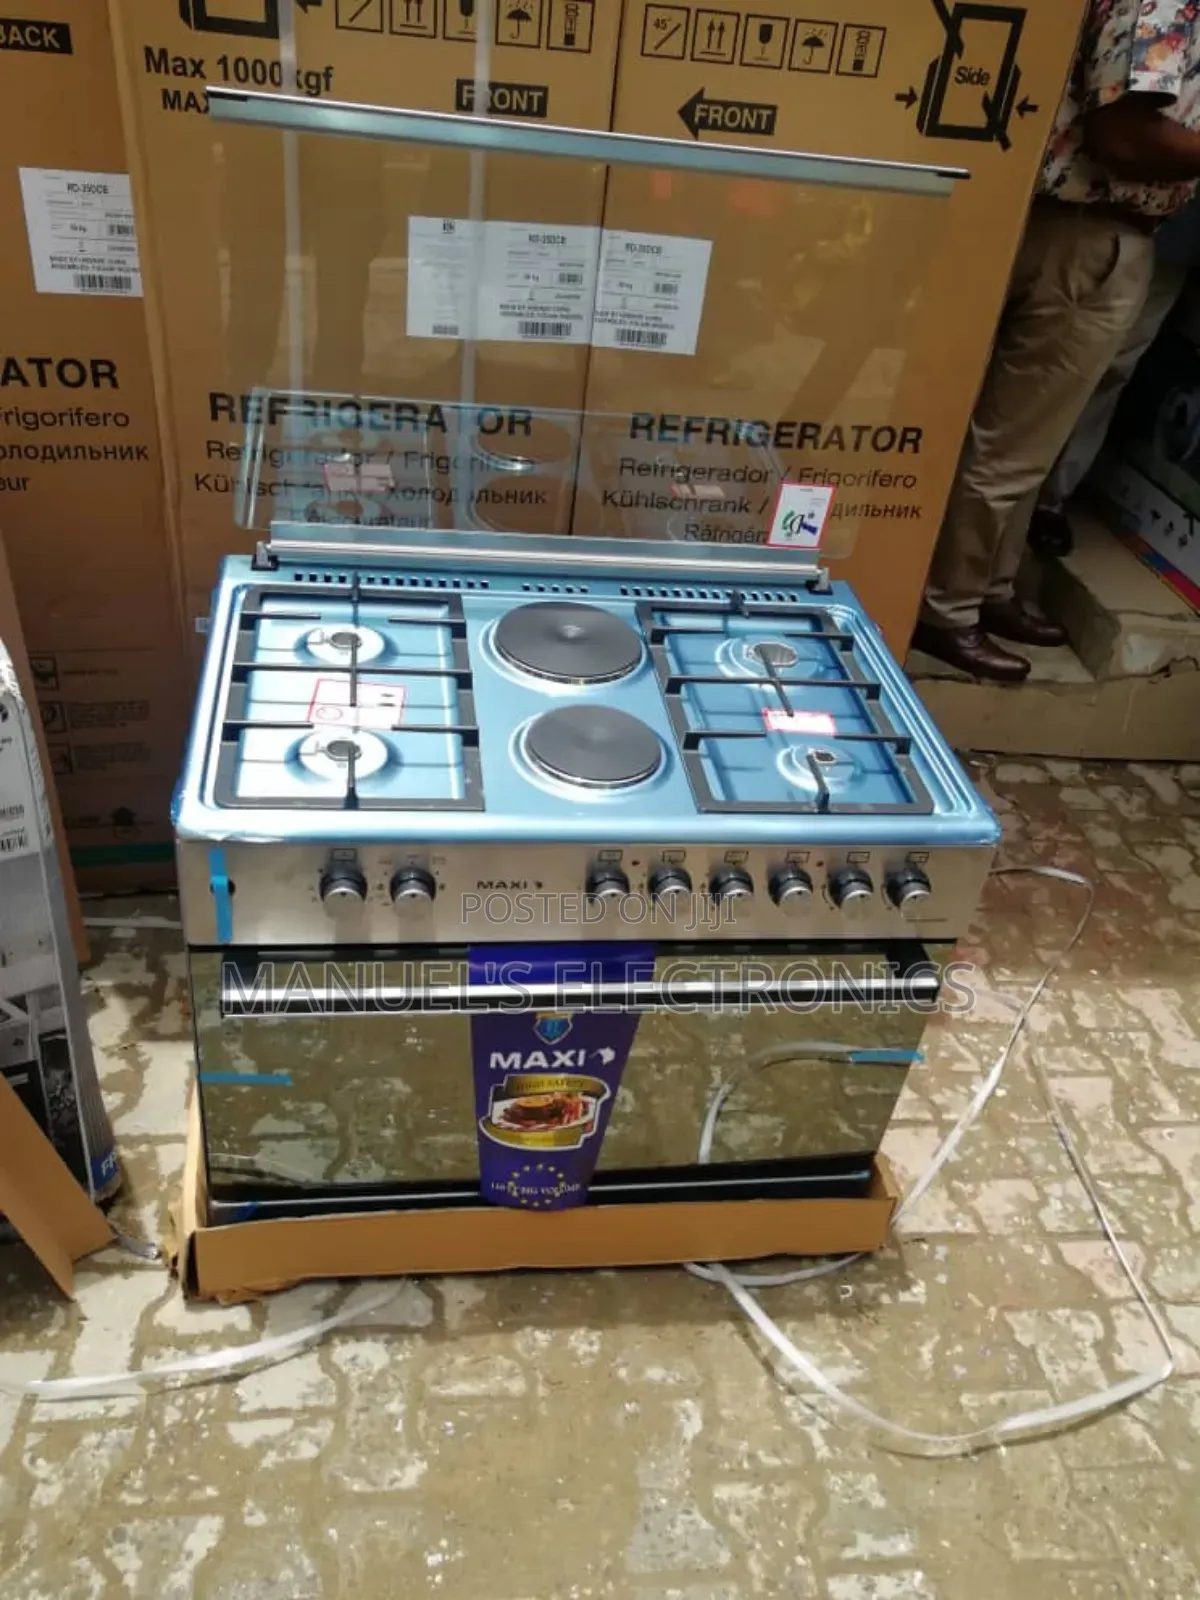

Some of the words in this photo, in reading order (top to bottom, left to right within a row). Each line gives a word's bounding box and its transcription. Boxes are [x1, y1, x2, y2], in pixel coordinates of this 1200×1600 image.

[144, 46, 206, 79] Max
[954, 65, 991, 86] Side
[462, 85, 544, 112] FONT
[694, 103, 772, 130] FRONT
[0, 406, 130, 431] rigorifero
[629, 411, 924, 455] REFRIGERATOR
[619, 457, 770, 484] Refrigerador
[798, 467, 918, 490] Frigorifero
[602, 489, 751, 514] Kühlschrank
[477, 880, 528, 890] MAXI
[489, 1049, 585, 1069] MAXI
